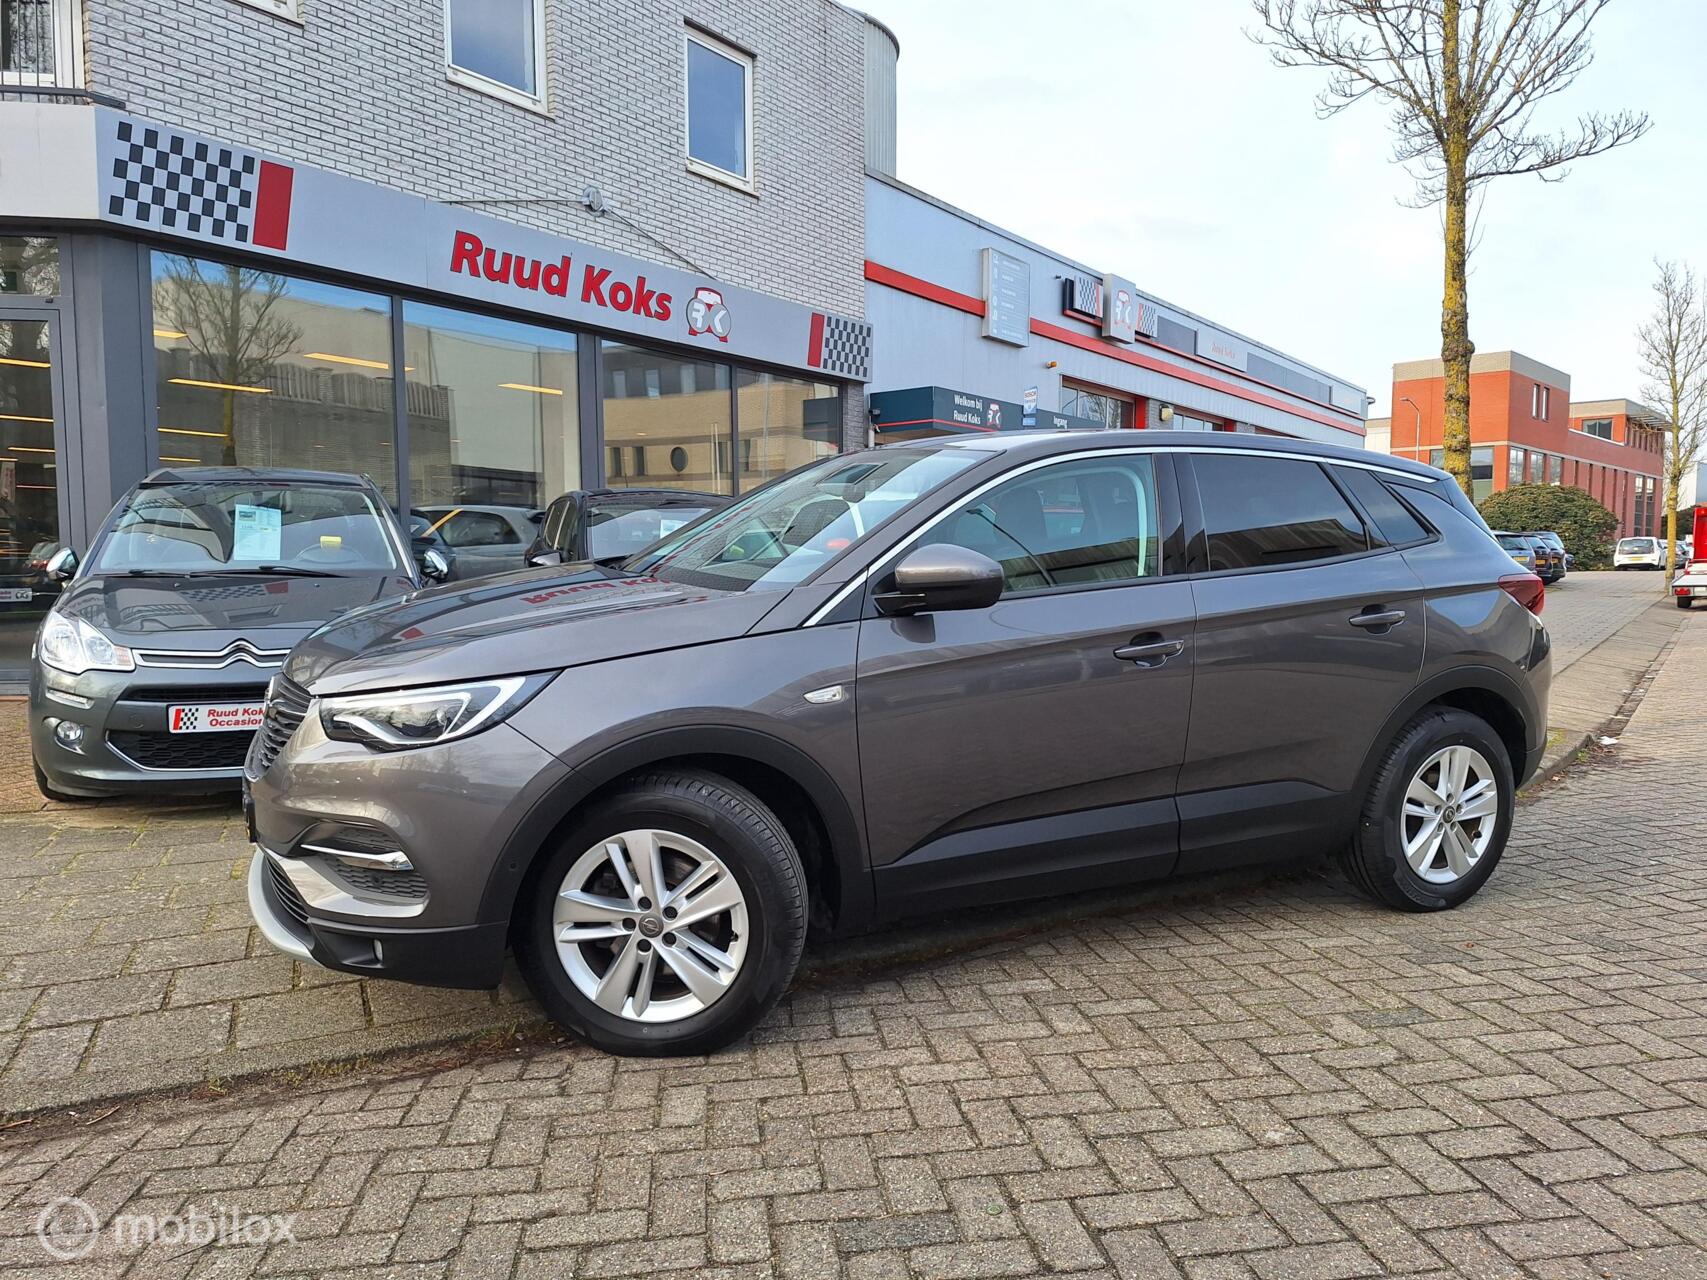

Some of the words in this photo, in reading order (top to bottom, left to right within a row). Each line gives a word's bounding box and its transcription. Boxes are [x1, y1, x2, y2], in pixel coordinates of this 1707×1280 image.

[450, 230, 572, 298] Ruud
[581, 264, 673, 322] Koks
[954, 394, 976, 409] Welkom
[953, 410, 968, 422] Ruud
[968, 413, 981, 425] Koks
[1053, 415, 1068, 430] Ingang
[207, 708, 239, 718] Ruud
